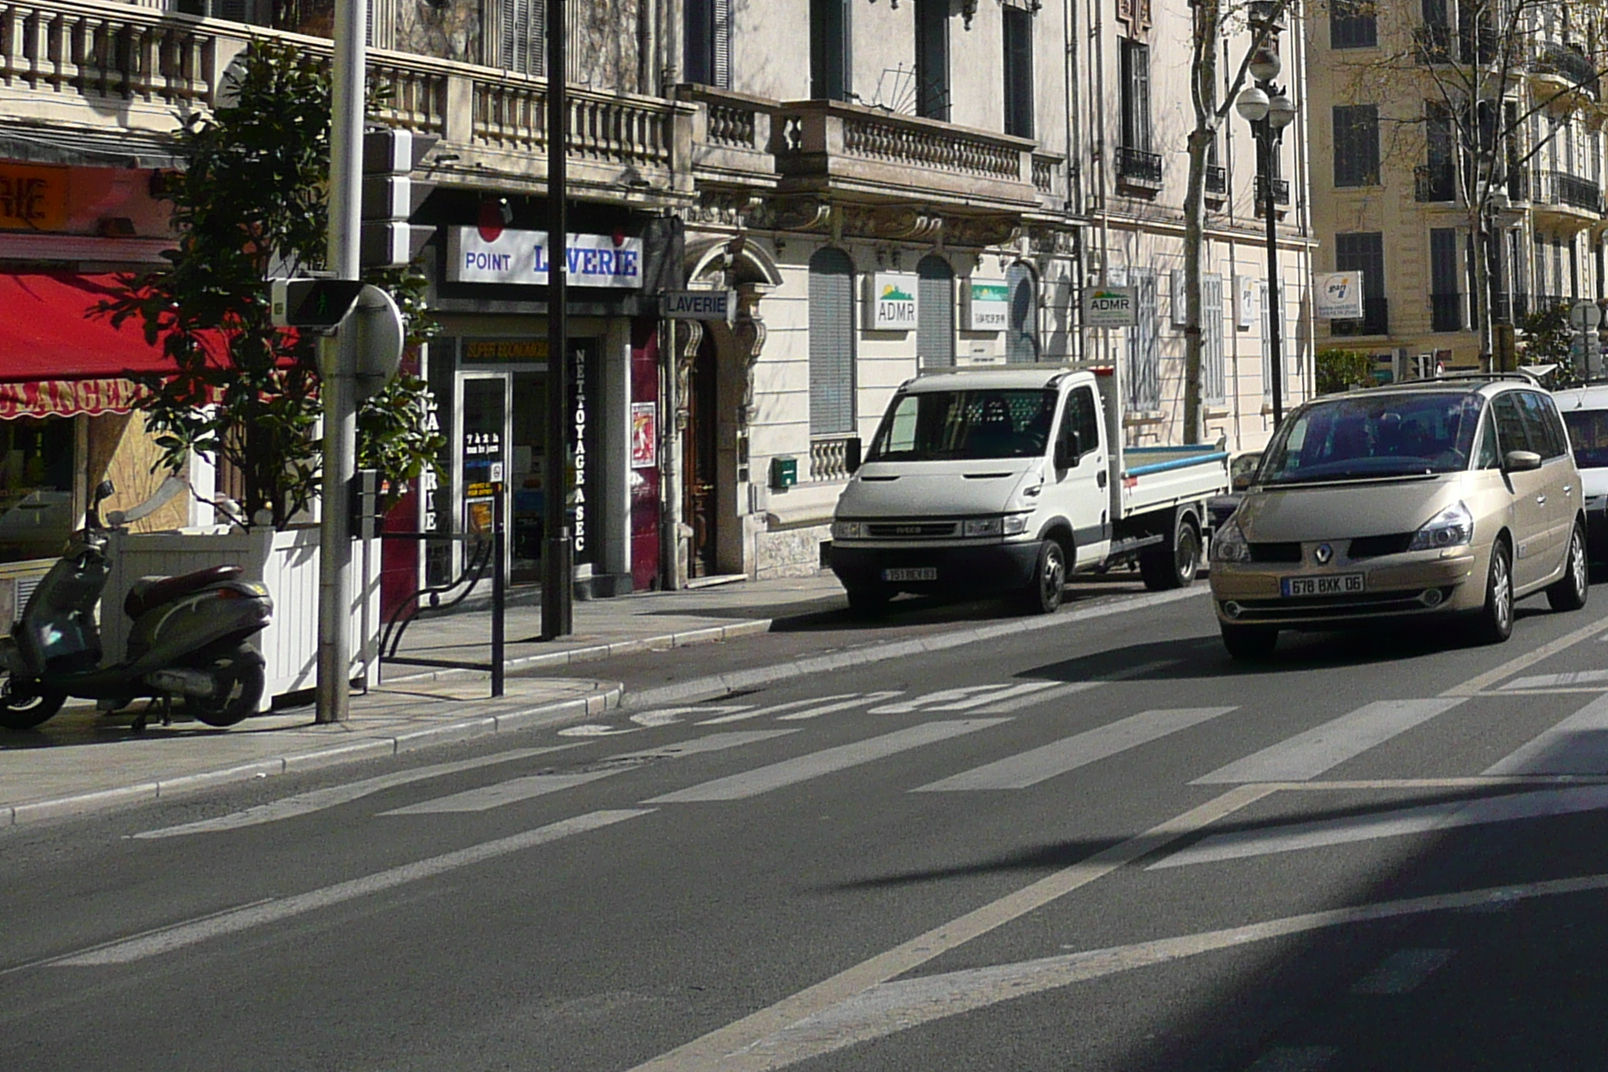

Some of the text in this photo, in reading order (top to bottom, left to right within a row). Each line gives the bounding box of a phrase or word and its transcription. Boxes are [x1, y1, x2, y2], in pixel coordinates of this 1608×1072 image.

[466, 245, 637, 276] POINT LVERIE
[667, 295, 726, 313] LAVERIE
[878, 302, 915, 322] ADMR
[1091, 299, 1130, 311] ADMR
[426, 392, 440, 531] LARIE
[1292, 577, 1360, 594] 678 BXK 06
